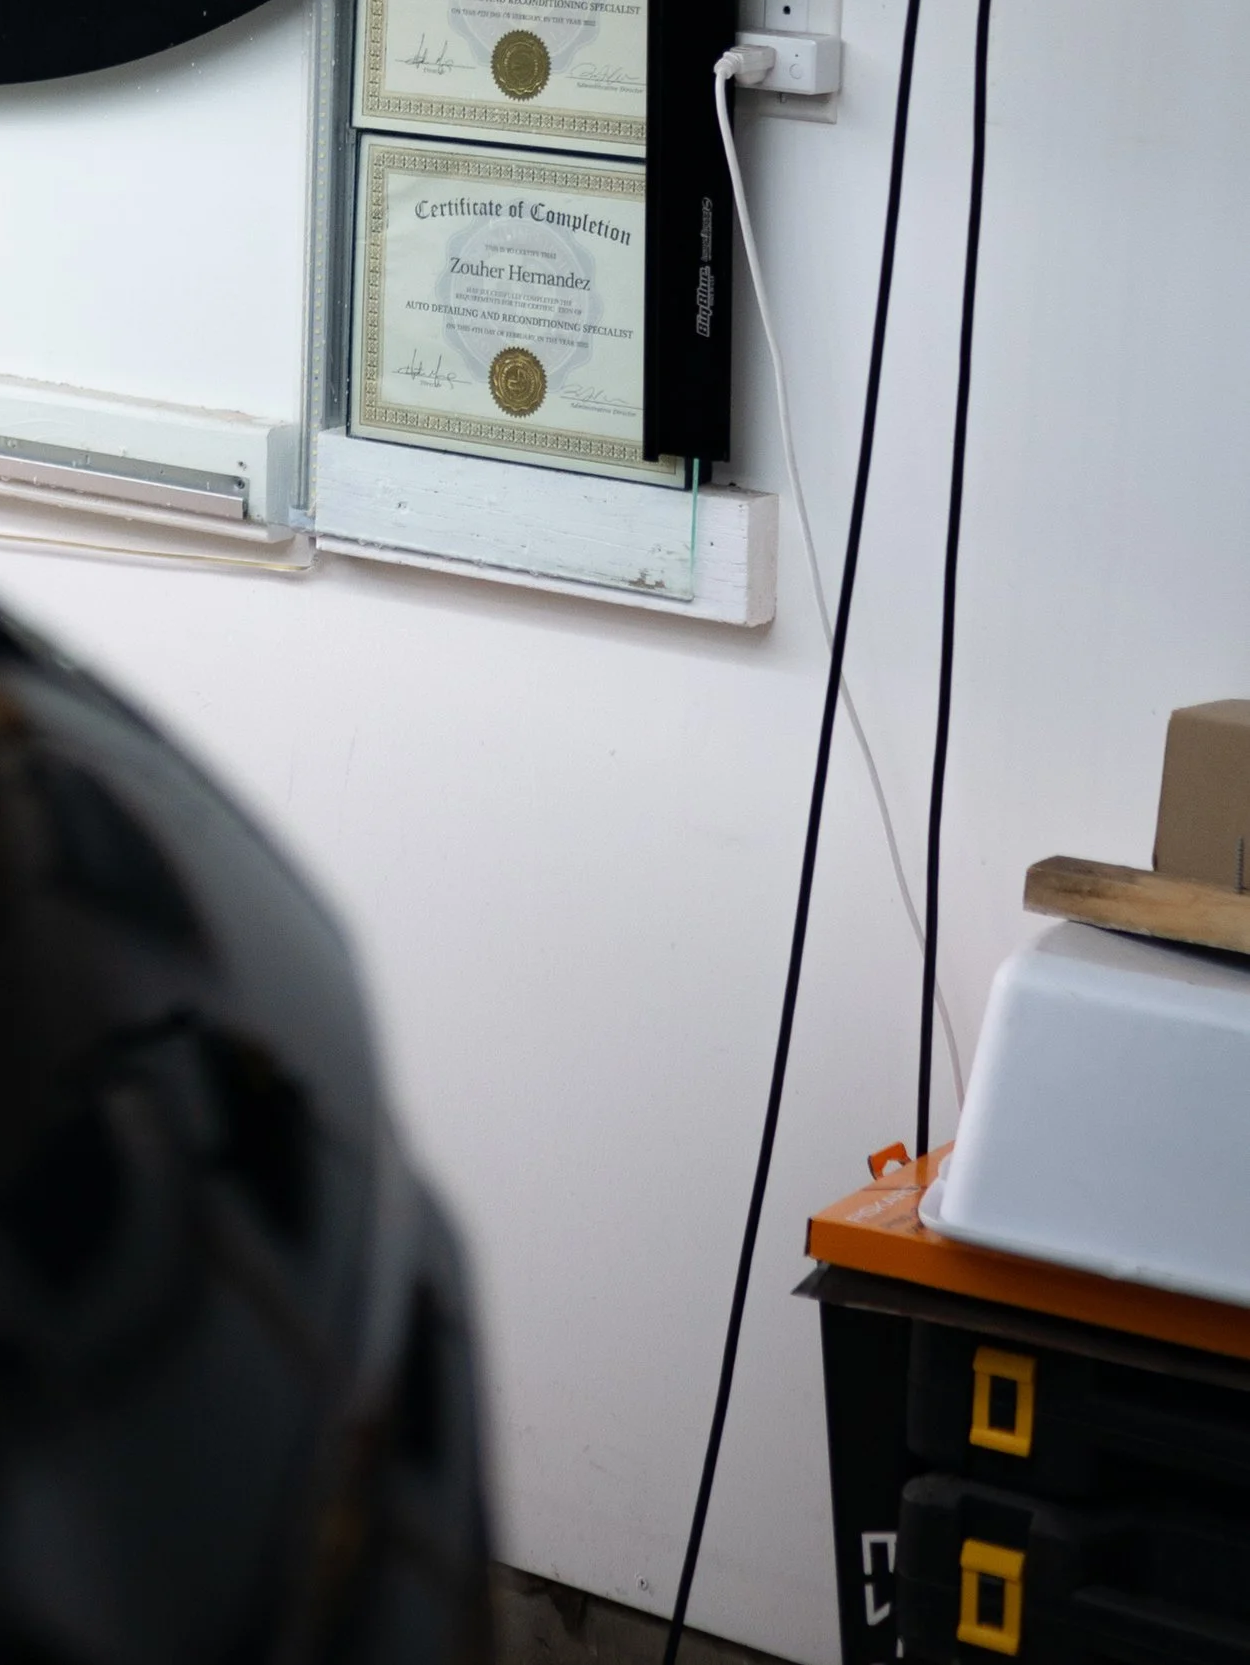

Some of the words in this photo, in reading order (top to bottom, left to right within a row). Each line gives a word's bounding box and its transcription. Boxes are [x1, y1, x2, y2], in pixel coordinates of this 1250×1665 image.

[590, 2, 641, 15] SPECIALIST
[415, 198, 502, 219] Certificate
[508, 200, 525, 219] of
[530, 202, 632, 247] Completion
[450, 257, 505, 279] Zouher
[509, 264, 591, 291] Hernandez
[405, 300, 430, 312] AUTO
[431, 303, 478, 319] DETAILING
[480, 310, 500, 322] AND
[502, 315, 581, 333] RECONDITIONING
[582, 324, 634, 340] SPECIALIST
